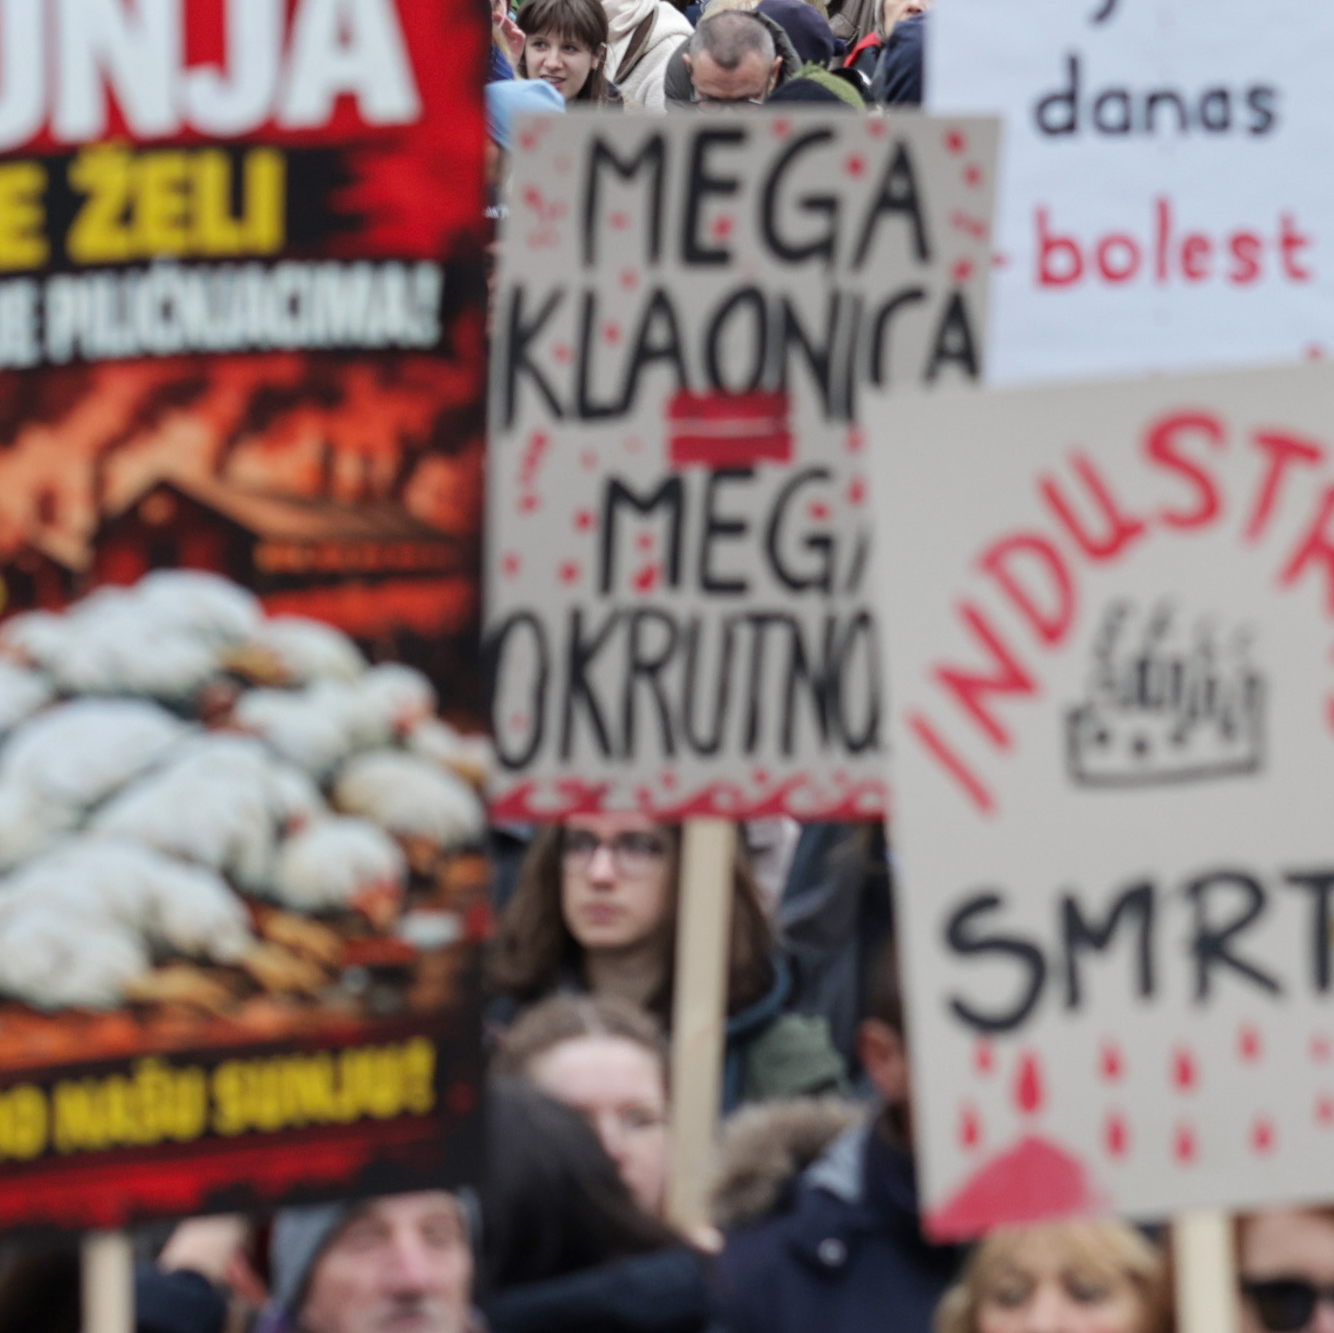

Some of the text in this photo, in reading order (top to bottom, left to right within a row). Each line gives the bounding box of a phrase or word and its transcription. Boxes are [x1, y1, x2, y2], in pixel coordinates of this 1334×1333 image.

[1033, 53, 1279, 138] danas
[67, 140, 287, 261] ŽELI
[578, 127, 932, 268] MEGA
[1031, 197, 1313, 291] bolest
